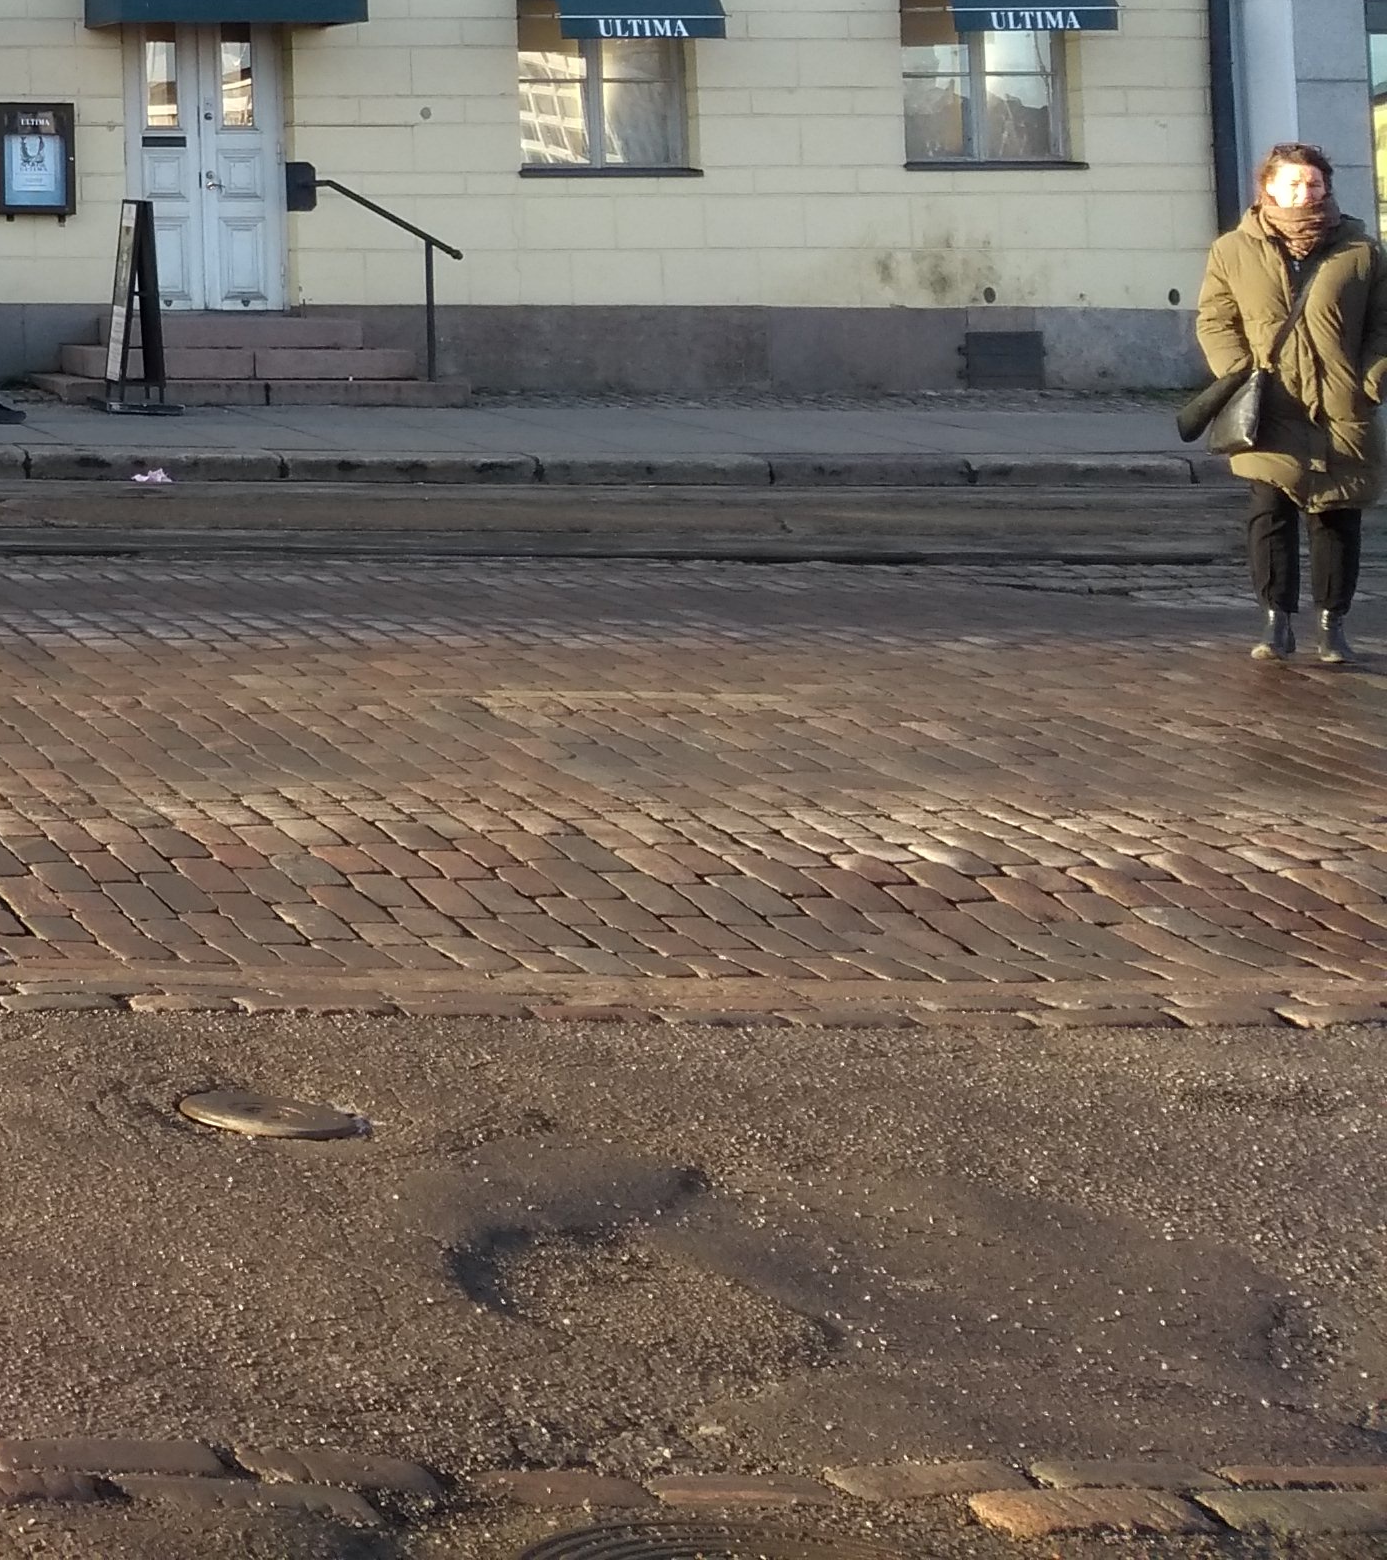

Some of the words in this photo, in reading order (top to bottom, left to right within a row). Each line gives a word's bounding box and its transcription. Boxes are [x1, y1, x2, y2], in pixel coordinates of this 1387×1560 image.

[598, 19, 690, 37] ULTIMA
[990, 10, 1082, 30] ULTIMA
[21, 118, 50, 126] ULTIMA
